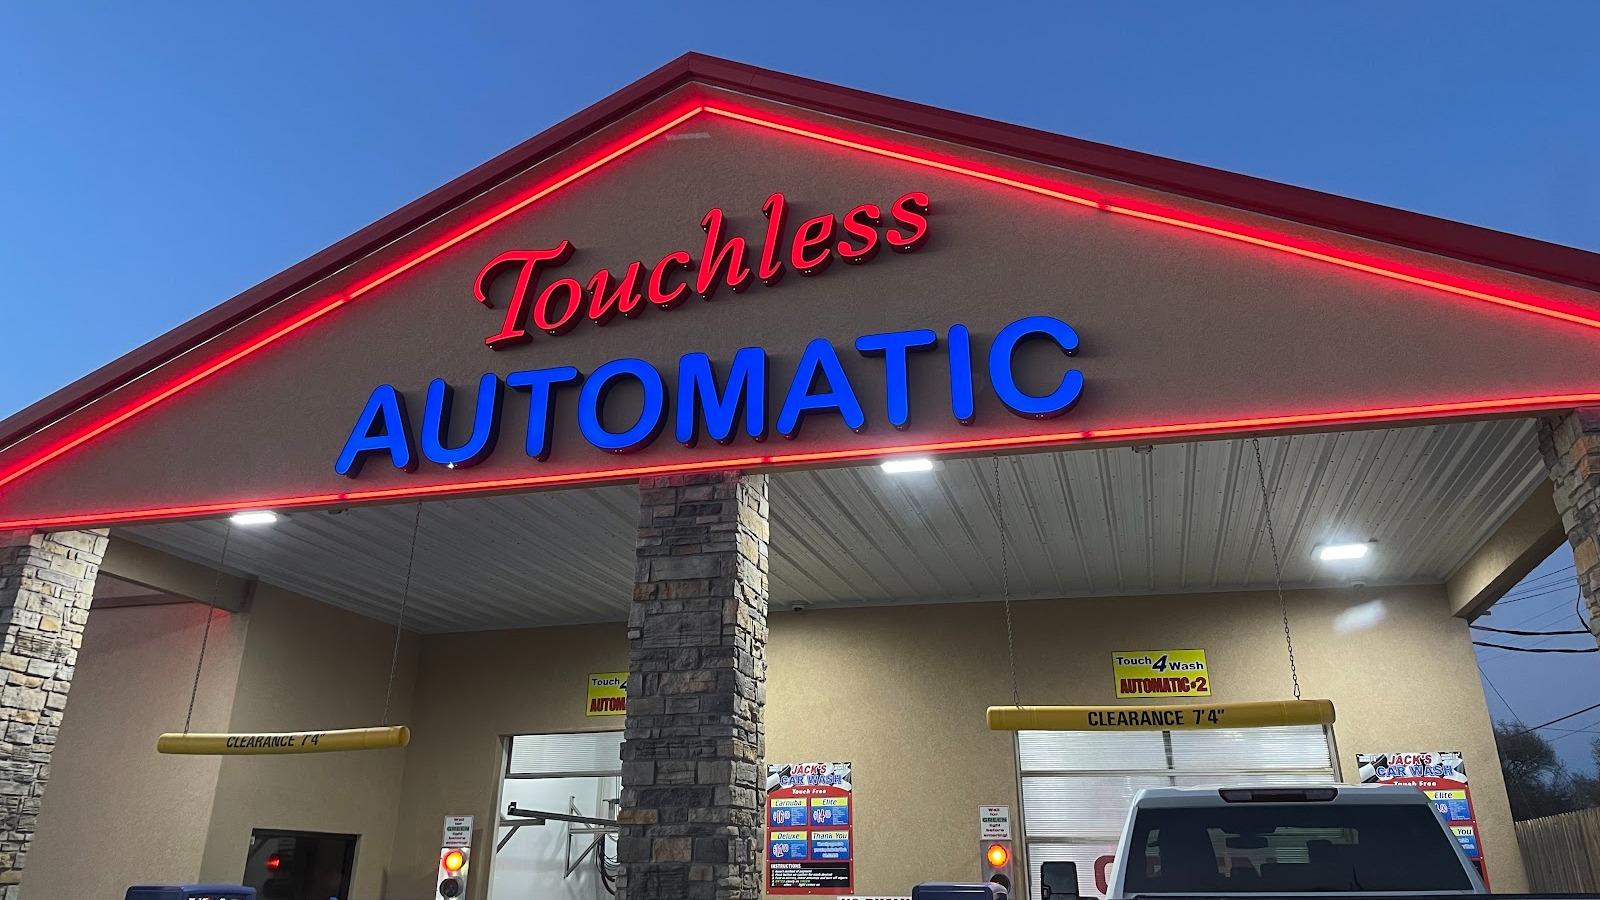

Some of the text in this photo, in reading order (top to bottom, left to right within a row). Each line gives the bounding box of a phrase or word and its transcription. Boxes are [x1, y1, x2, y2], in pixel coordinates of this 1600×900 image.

[473, 192, 931, 350] Touchless
[335, 315, 1084, 477] AUTOMATIC
[1116, 655, 1204, 672] Touch 4 Wash
[592, 678, 620, 686] Touch
[1087, 709, 1225, 727] CLEARANCE 7'4"
[226, 735, 295, 748] CLEARANCE
[1388, 754, 1432, 765] JACK'S
[791, 764, 827, 775] JACK'S
[1376, 765, 1454, 777] CAR WASH
[780, 774, 842, 785] CAR WASH
[1434, 791, 1453, 799] Elite
[822, 798, 838, 806] Elite
[777, 832, 800, 840] Deluxe
[813, 832, 833, 840] Thank
